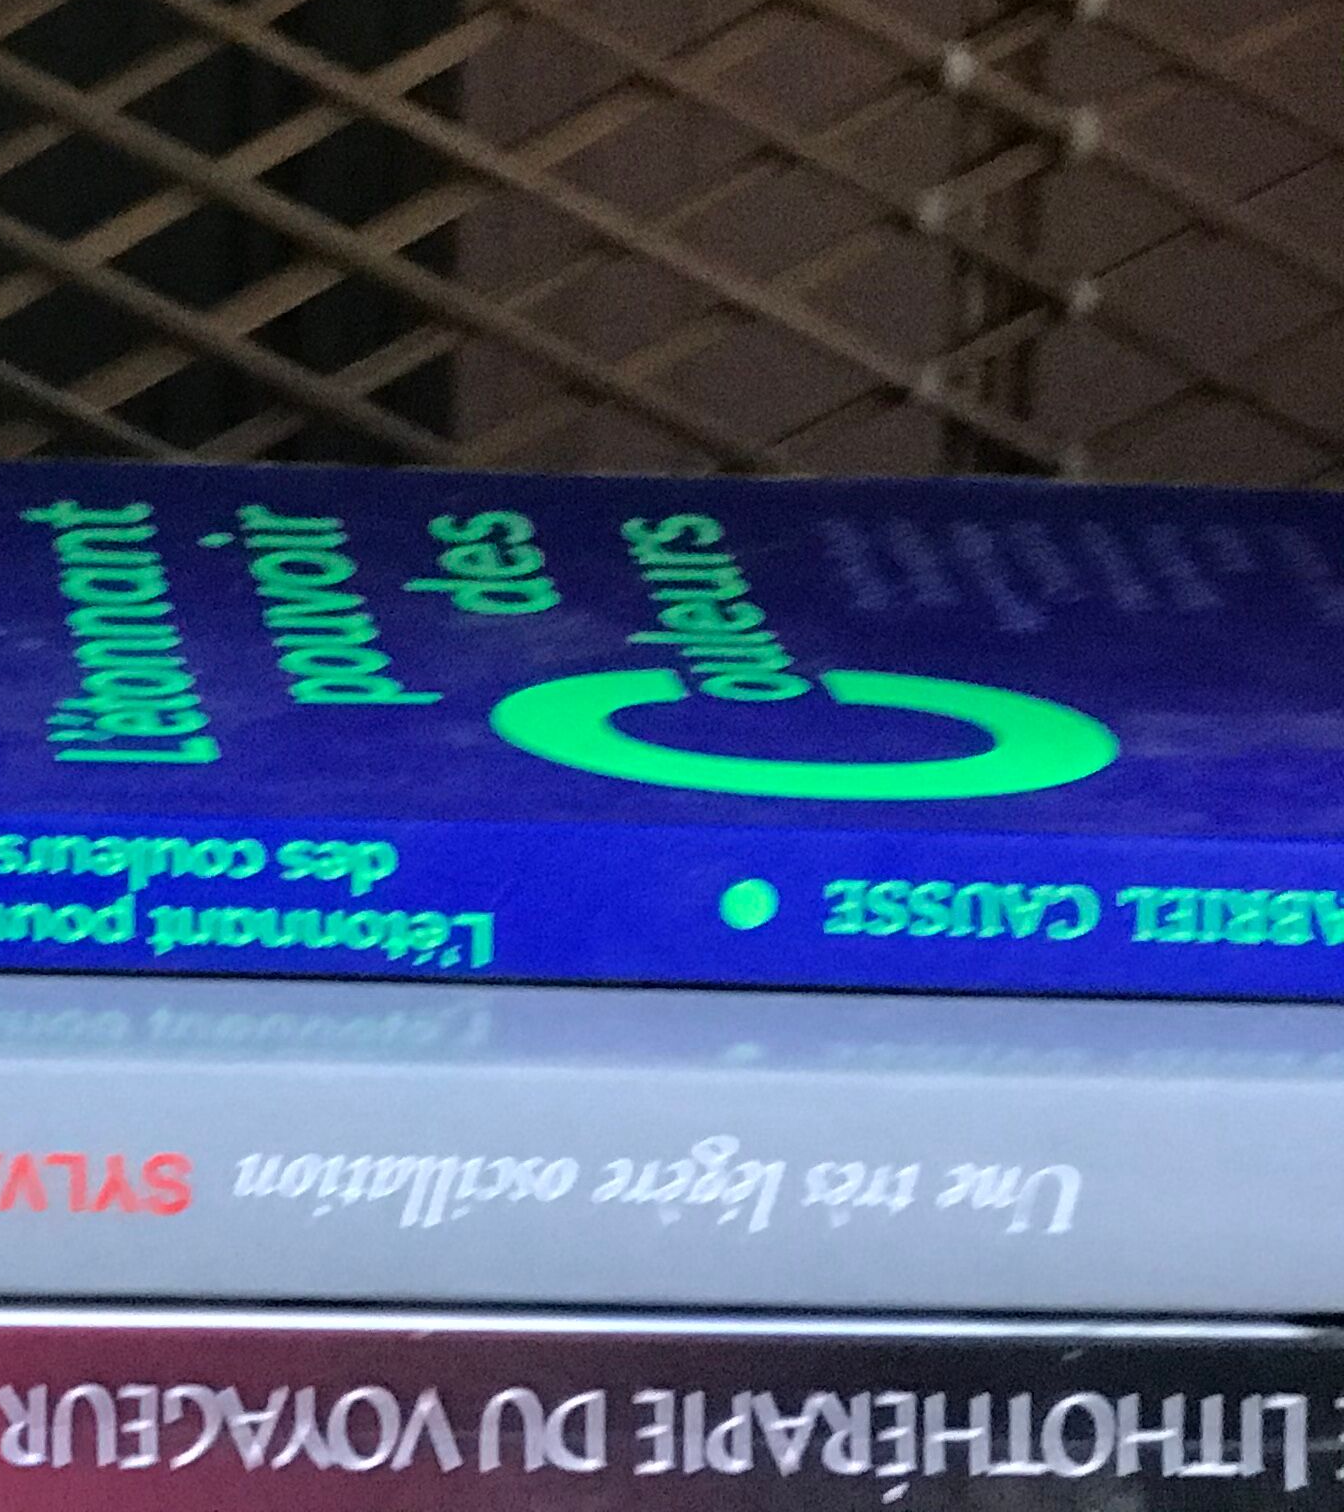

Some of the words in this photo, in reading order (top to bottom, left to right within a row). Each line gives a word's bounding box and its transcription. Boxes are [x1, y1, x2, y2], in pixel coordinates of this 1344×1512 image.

[402, 509, 562, 616] des
[19, 500, 221, 764] L'étonnant
[198, 503, 442, 705] pouvoir
[276, 840, 397, 896] des
[148, 906, 493, 976] L'étonnant
[824, 879, 1100, 940] CAUSSE
[234, 1153, 579, 1226] oscillation
[592, 1135, 786, 1232] légère
[802, 1161, 920, 1226] très
[937, 1162, 1082, 1233] Une
[479, 1388, 606, 1473] DU
[633, 1389, 1308, 1503] LITHOTHÉRAPIE
